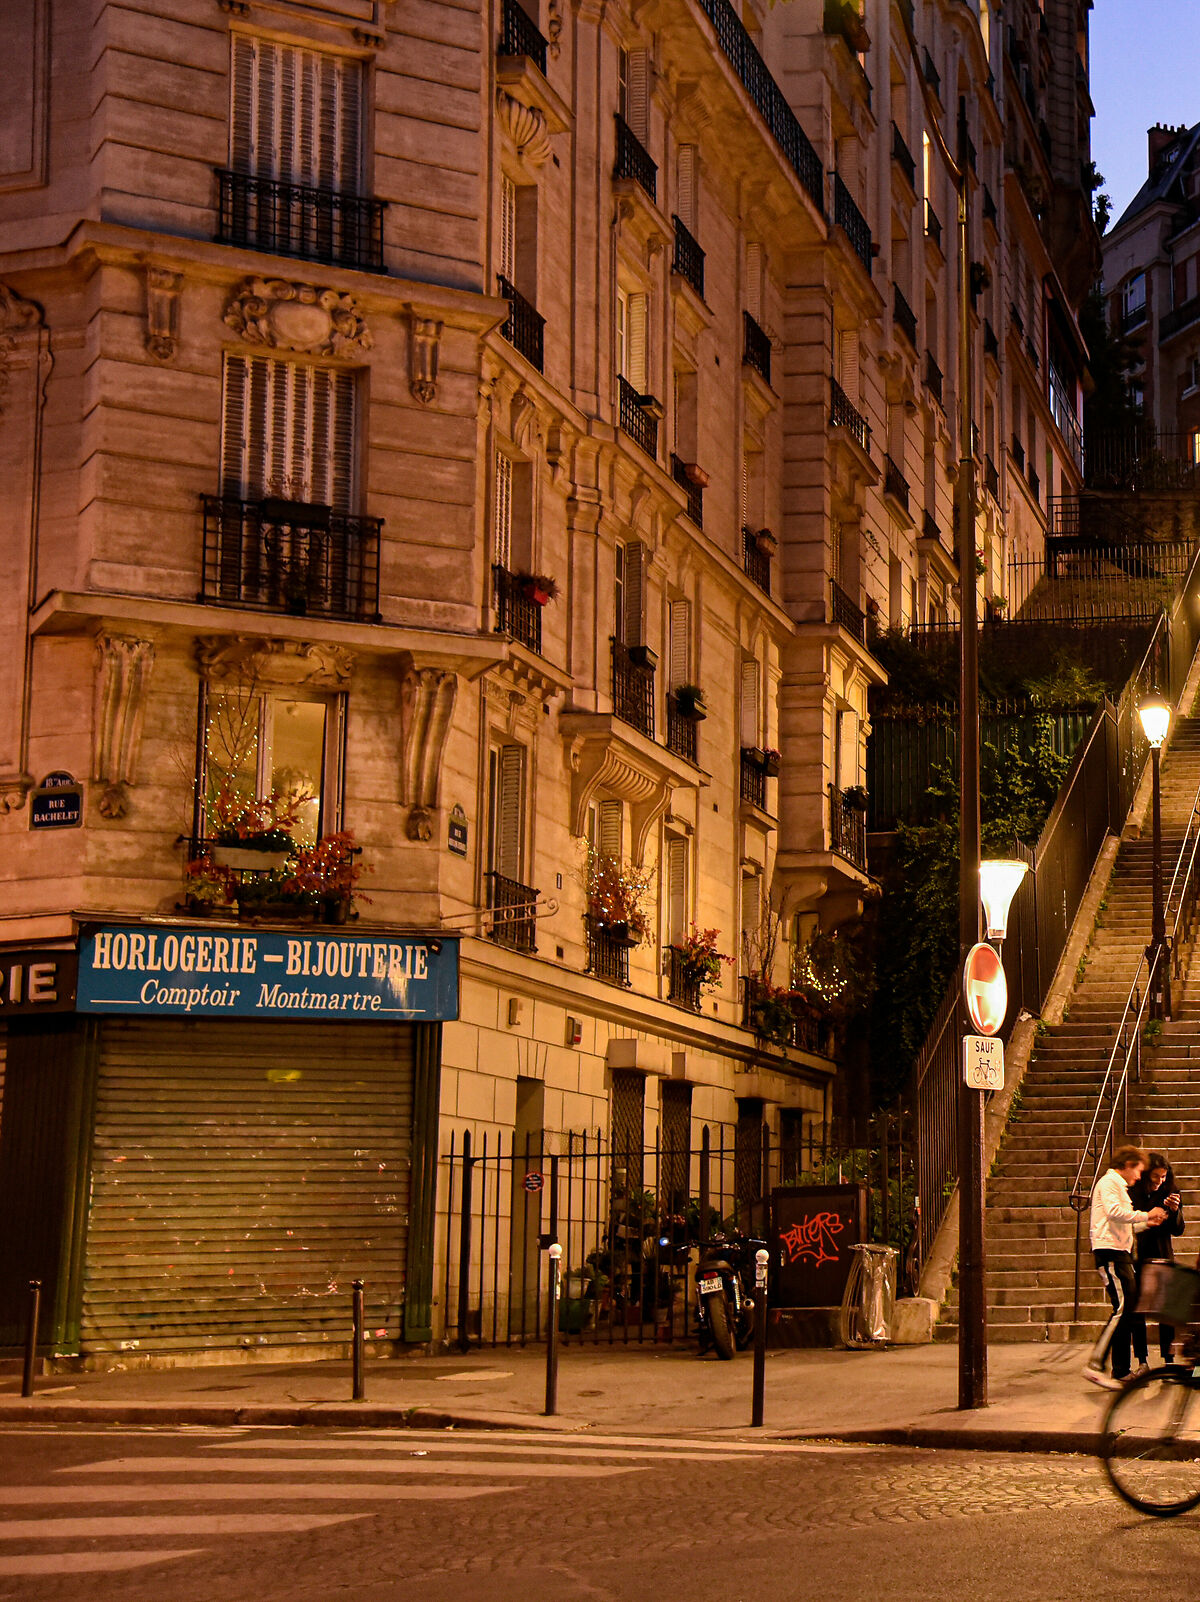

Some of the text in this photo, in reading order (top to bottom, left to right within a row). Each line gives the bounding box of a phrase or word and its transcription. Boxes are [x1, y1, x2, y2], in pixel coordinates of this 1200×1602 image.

[33, 810, 79, 822] BACHELET
[48, 799, 65, 809] RUE
[92, 932, 258, 974] HORLOGERIE
[285, 939, 428, 980] BIJOUTERIE
[0, 963, 57, 1004] IE
[140, 978, 382, 1012] Comptoir Montmartre
[975, 1040, 995, 1054] SAUF
